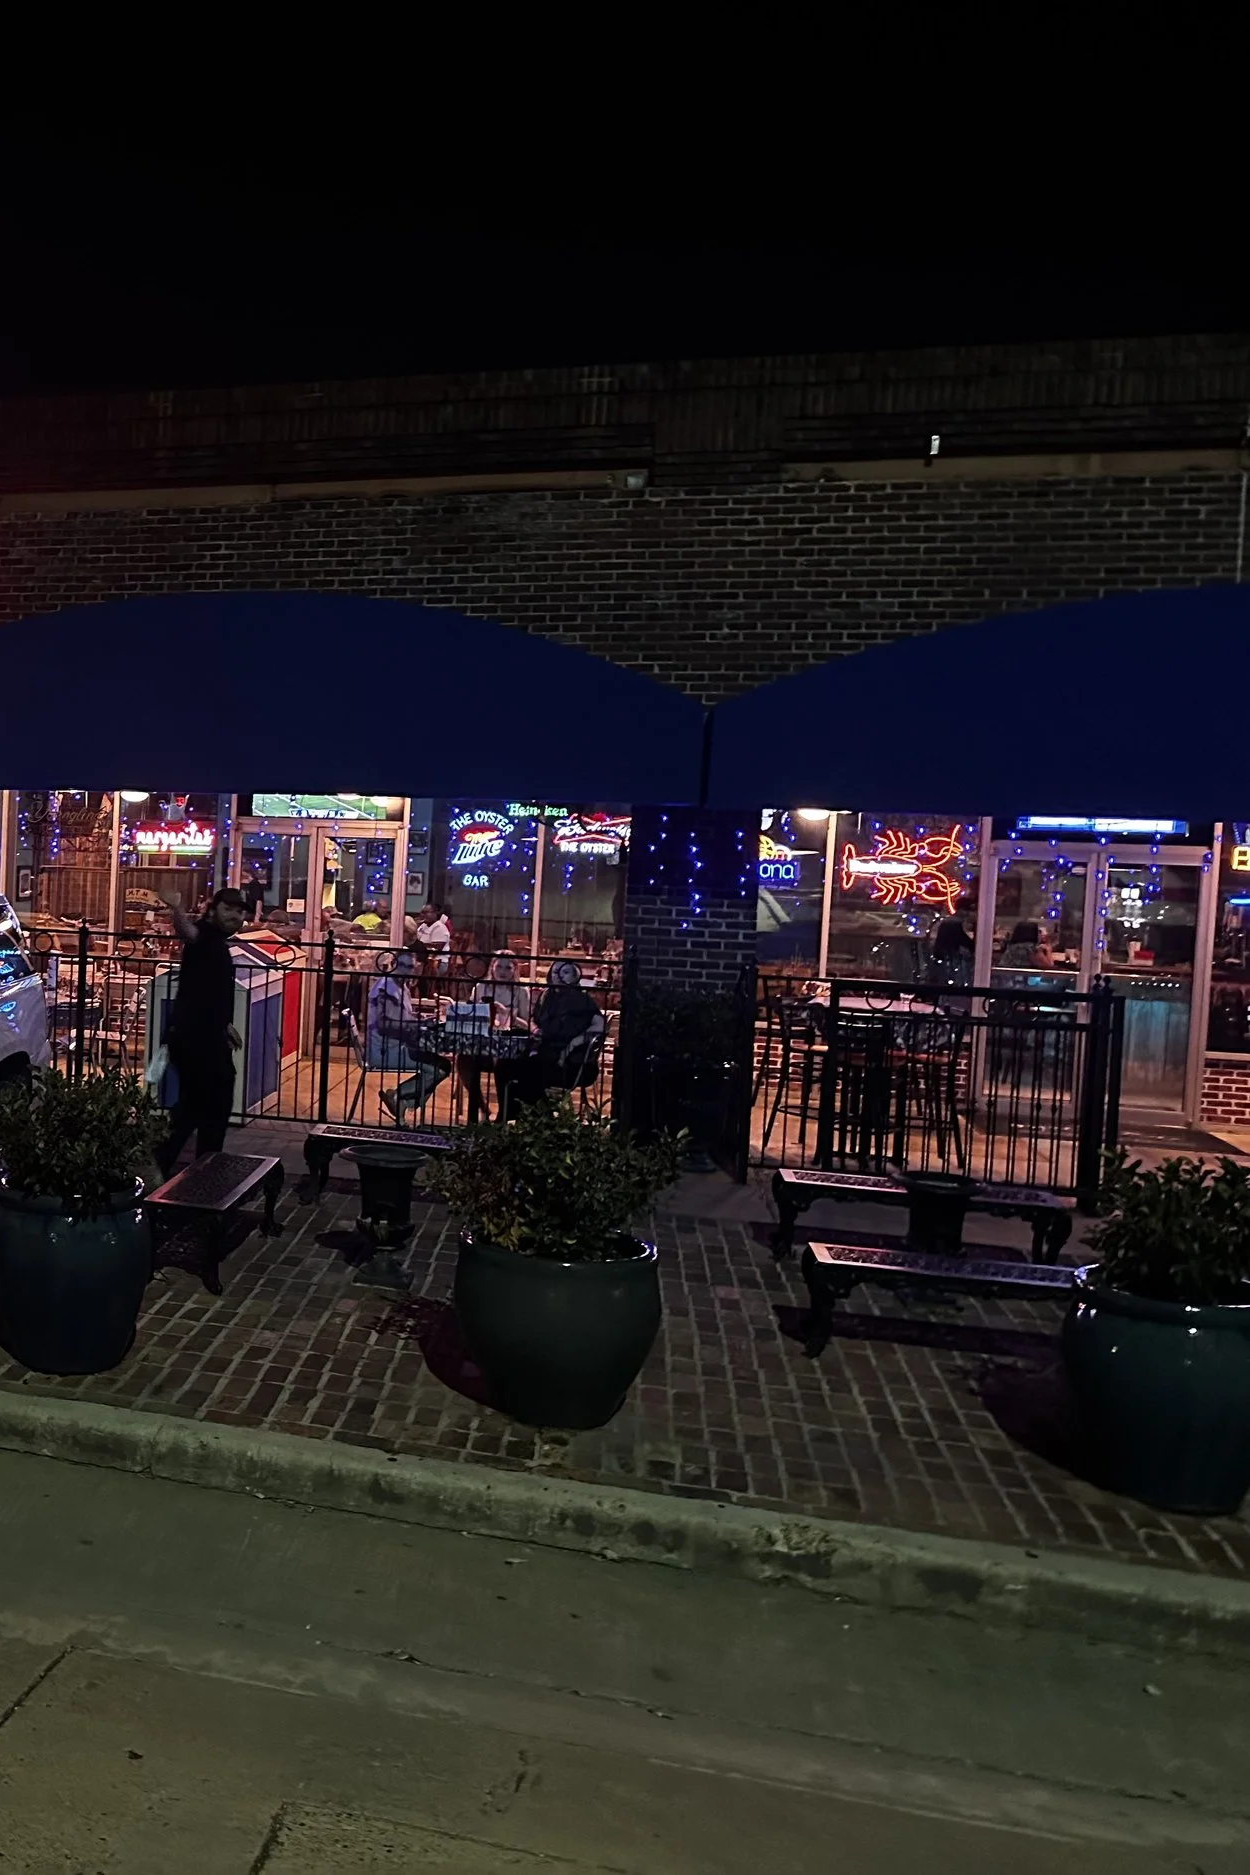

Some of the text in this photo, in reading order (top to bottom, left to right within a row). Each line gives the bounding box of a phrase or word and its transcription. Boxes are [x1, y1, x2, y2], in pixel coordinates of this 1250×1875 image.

[508, 803, 569, 816] Heinken
[450, 811, 514, 835] THE OYSTER
[560, 841, 615, 854] THE OYSTER
[463, 874, 489, 887] BAR
